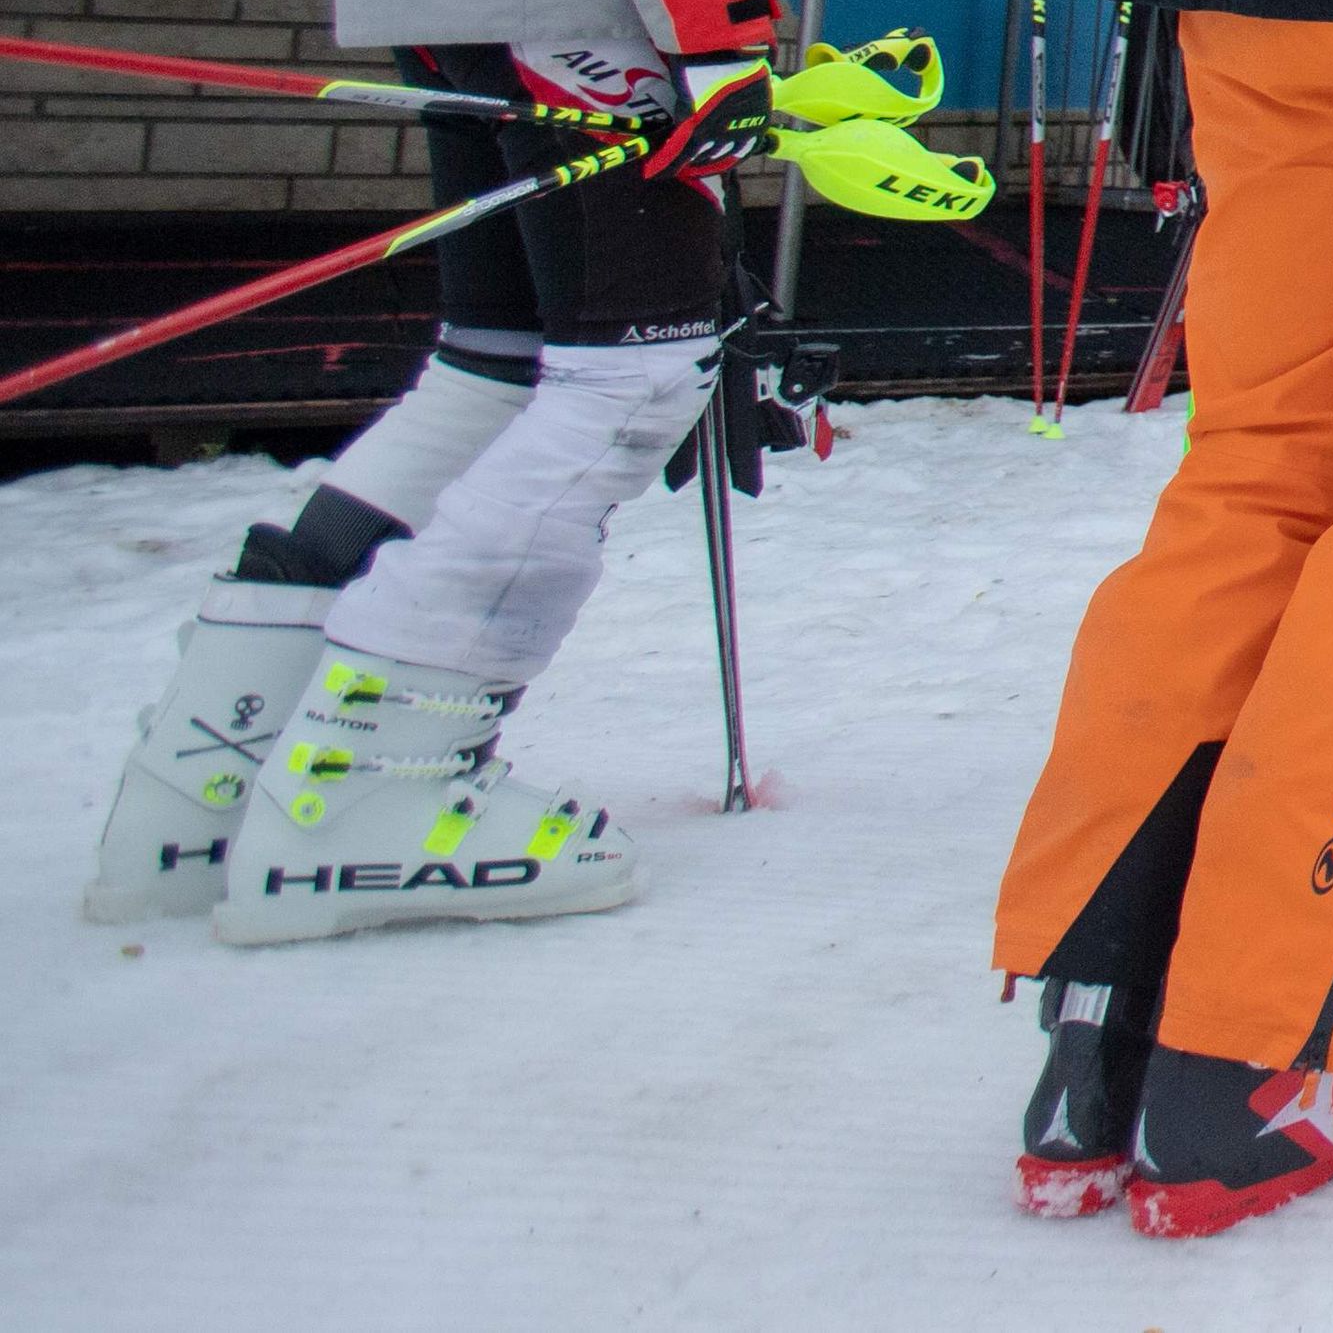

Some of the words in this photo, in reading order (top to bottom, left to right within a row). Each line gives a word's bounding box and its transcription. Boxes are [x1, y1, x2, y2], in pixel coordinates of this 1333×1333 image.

[727, 115, 767, 131] LEKI
[556, 135, 651, 187] LEKI
[463, 181, 540, 218] WORLDCUP
[875, 175, 977, 213] LEKI
[644, 319, 716, 341] Schöffel
[305, 709, 379, 732] RAPTOR
[265, 857, 542, 897] HEAD
